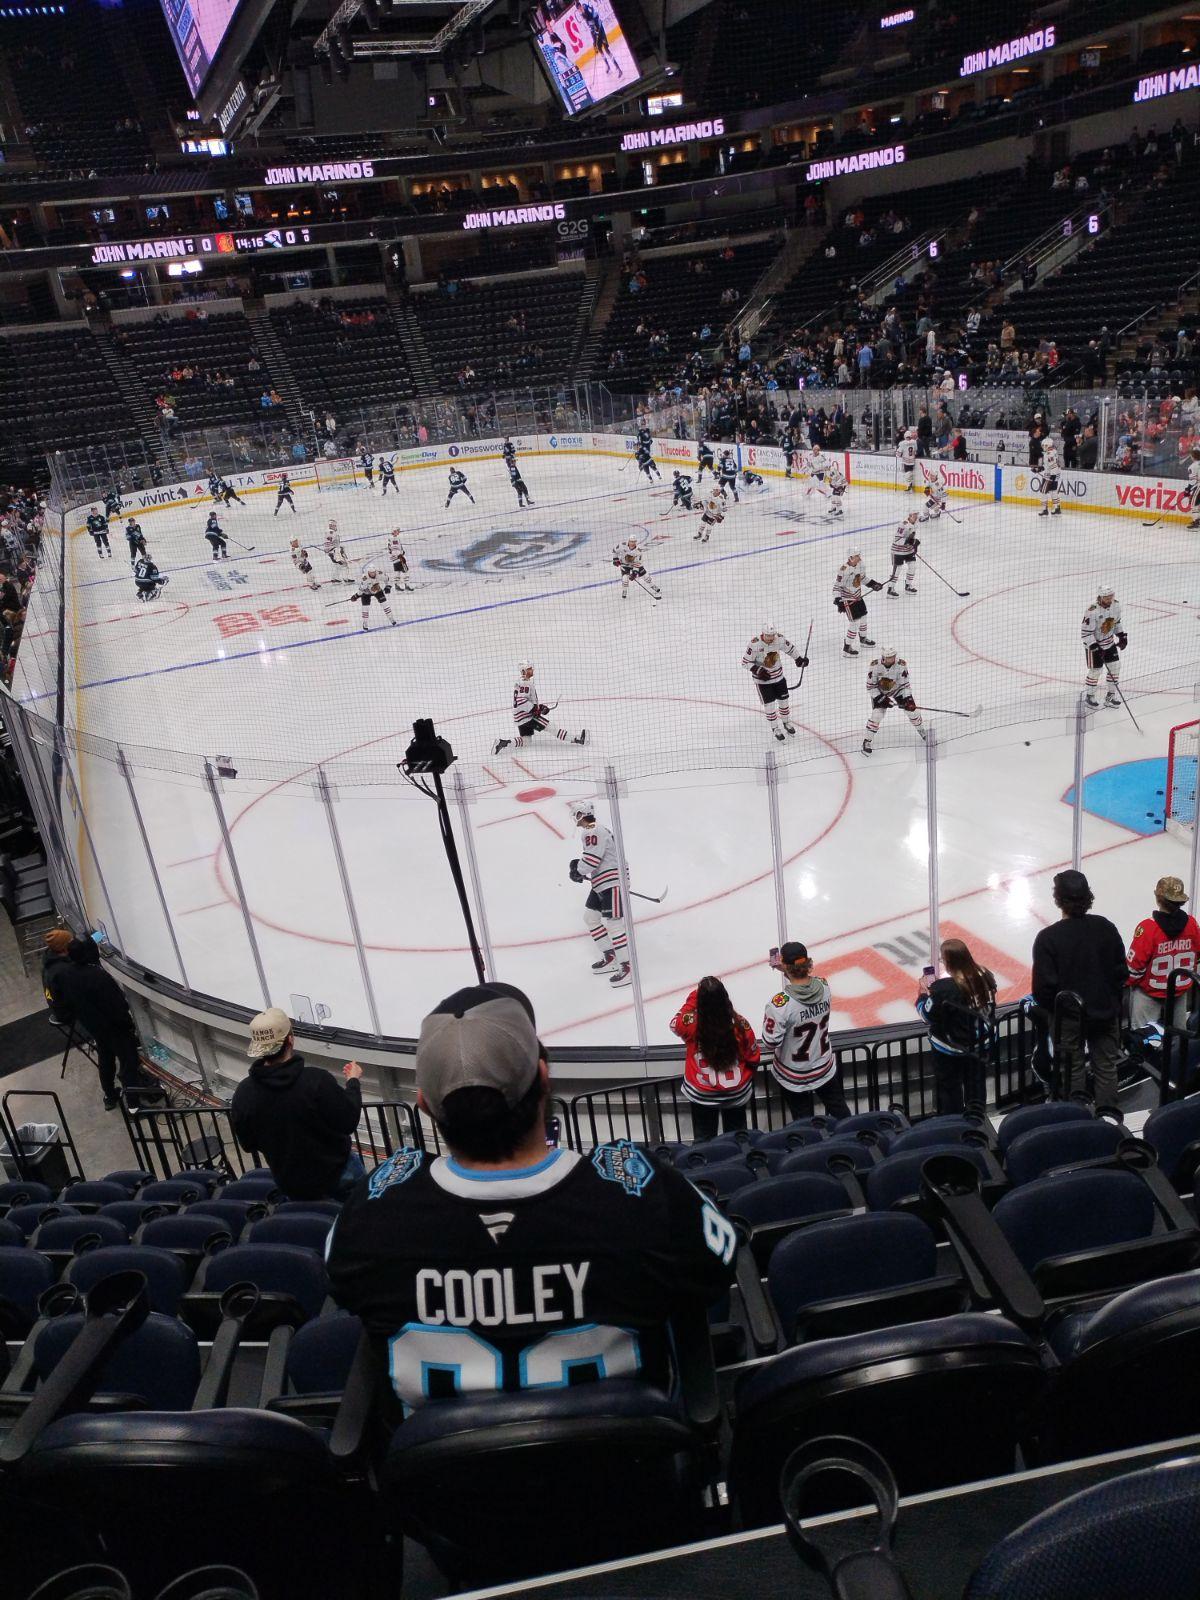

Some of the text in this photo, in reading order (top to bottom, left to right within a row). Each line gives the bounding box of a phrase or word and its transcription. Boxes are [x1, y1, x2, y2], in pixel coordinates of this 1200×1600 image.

[881, 10, 914, 28] MARINO
[960, 26, 1055, 77] JOHN MARINO 6
[1134, 73, 1167, 101] JOHN
[620, 119, 724, 151] JOHN MARINO 6
[265, 162, 374, 185] JOHN MARINO 6
[806, 145, 904, 181] JOHN MARINO 6
[463, 204, 565, 229] JOHN MARINO 6
[557, 219, 589, 235] G2G
[1088, 215, 1098, 233] 6
[201, 239, 212, 252] 0
[235, 237, 264, 249] 14:16
[285, 231, 295, 244] 0
[92, 245, 126, 263] JOHN
[929, 241, 938, 257] 6
[958, 374, 968, 390] 6
[560, 436, 583, 445] moxie
[939, 464, 985, 490] Smith's
[1030, 476, 1087, 497] OAND
[139, 489, 176, 508] vivint
[1158, 938, 1192, 954] BEDARD
[1149, 951, 1196, 989] 98
[799, 1000, 831, 1021] PANARIN
[791, 1013, 830, 1062] 72
[611, 1149, 625, 1182] SEASON
[702, 1203, 737, 1266] 9
[415, 1261, 591, 1327] COOLEY
